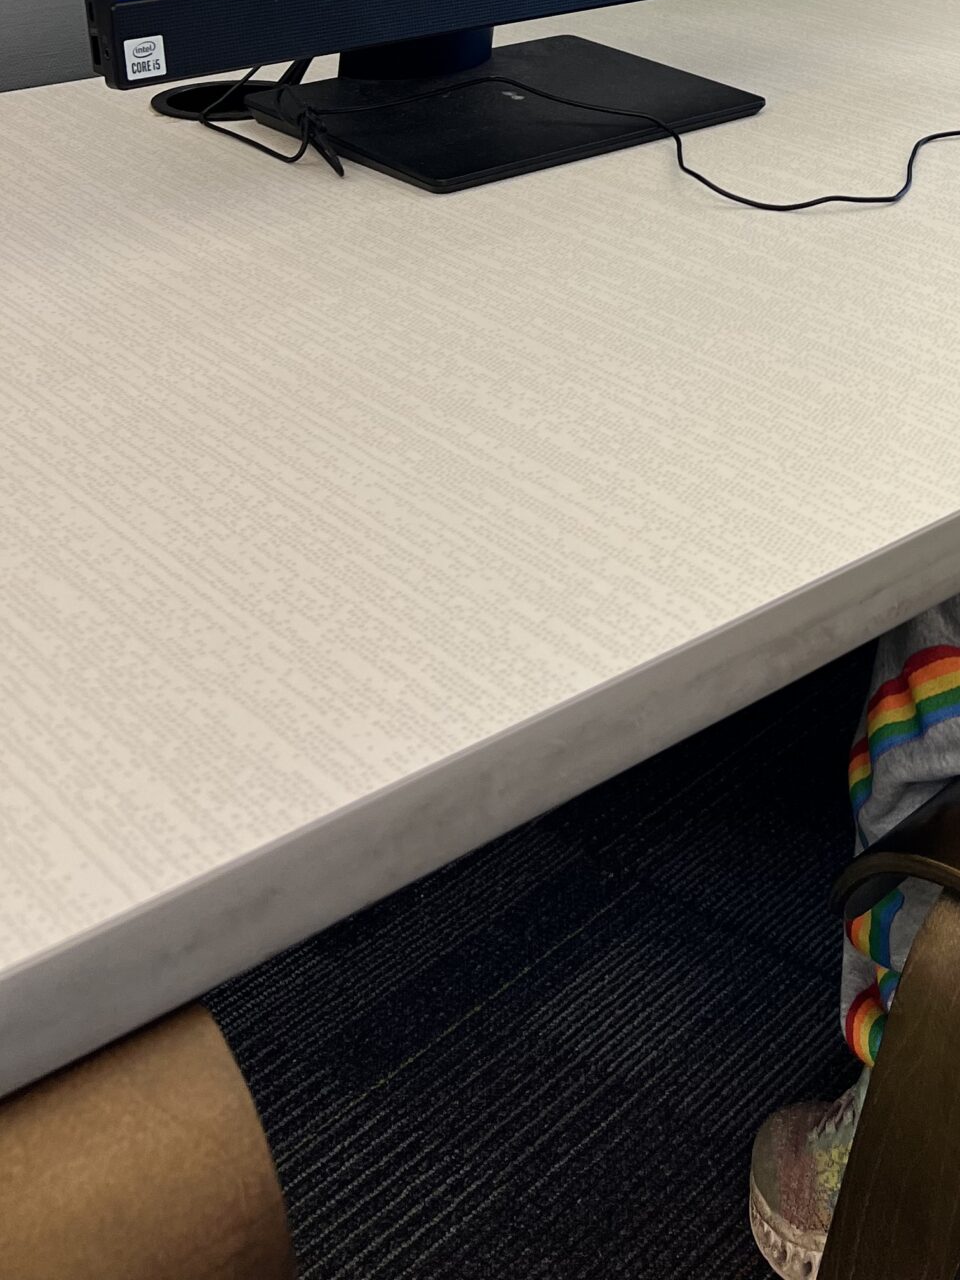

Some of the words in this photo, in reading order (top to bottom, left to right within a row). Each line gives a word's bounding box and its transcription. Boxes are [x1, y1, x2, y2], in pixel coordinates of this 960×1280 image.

[136, 44, 152, 54] intel
[131, 60, 152, 75] CORE
[152, 58, 161, 71] i5
